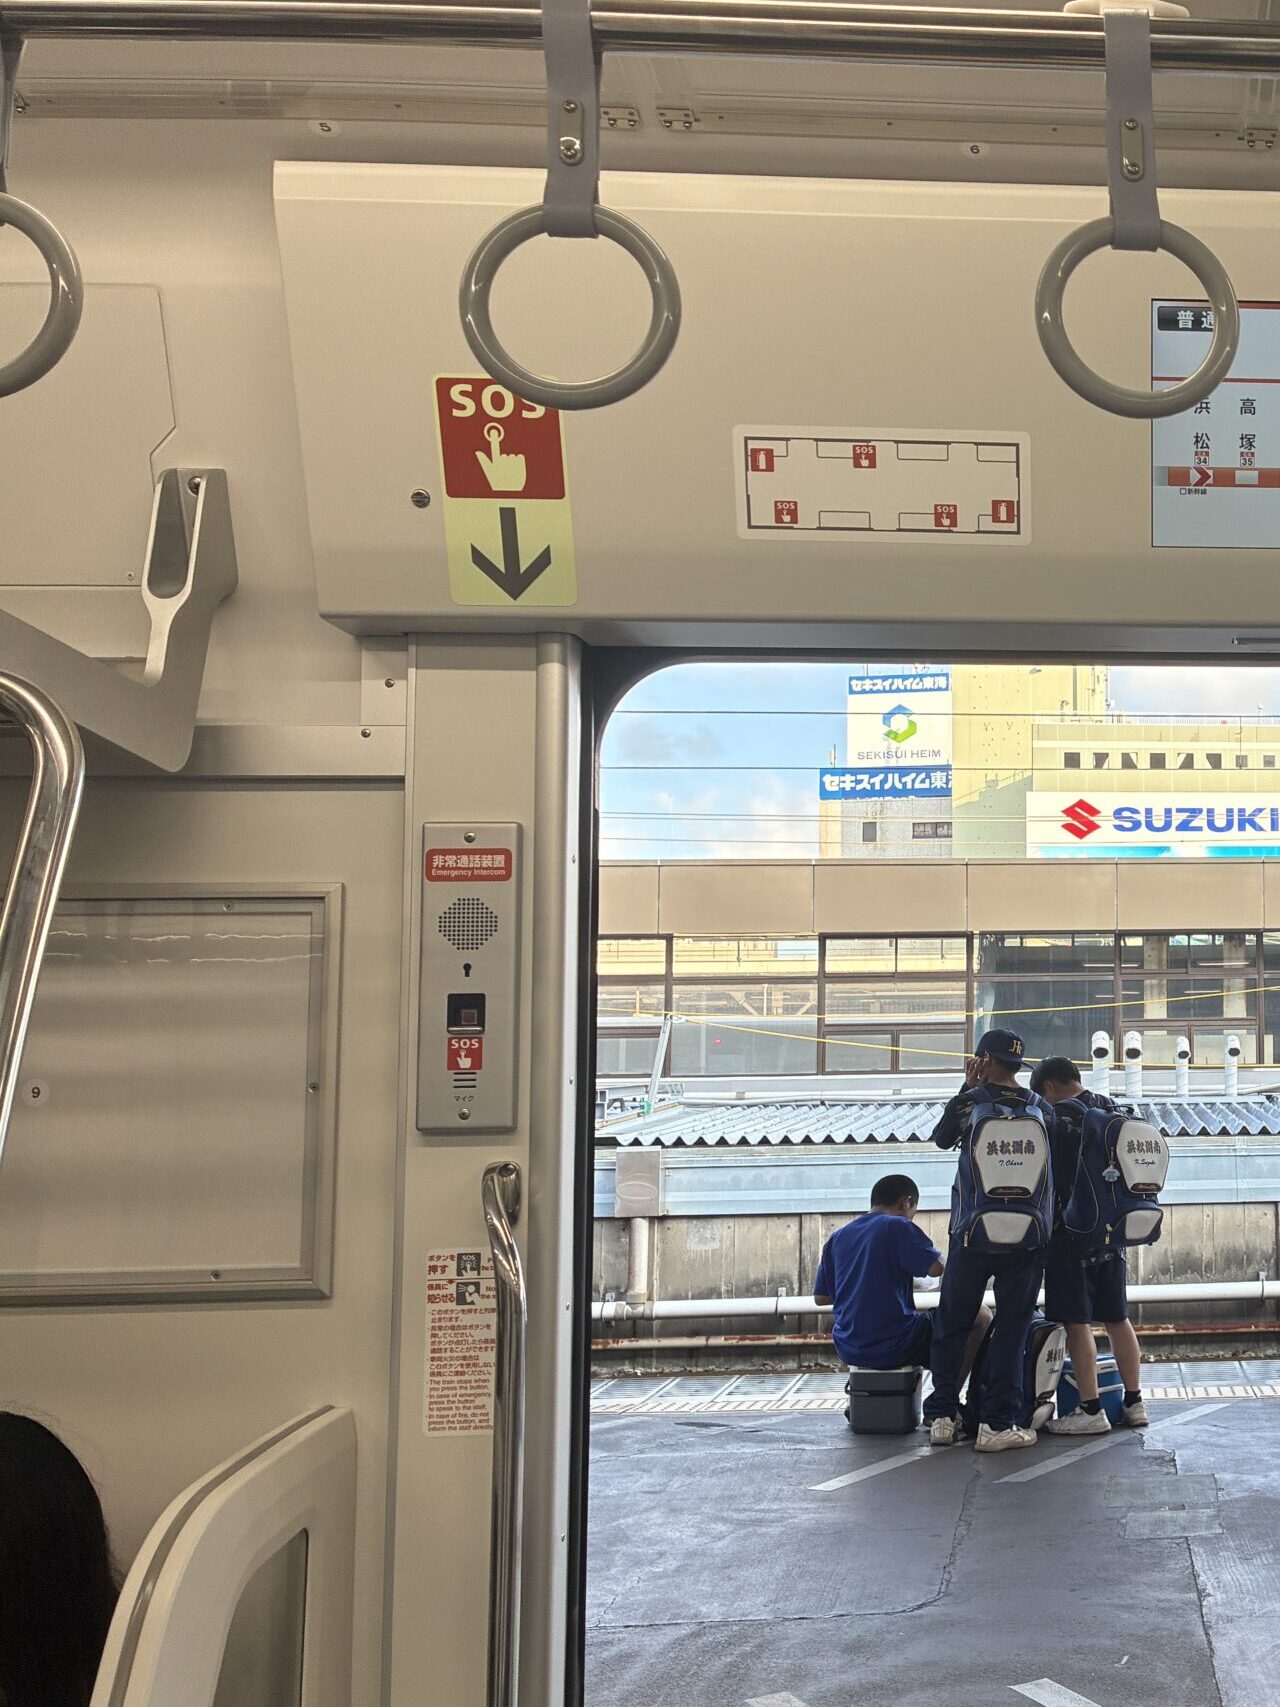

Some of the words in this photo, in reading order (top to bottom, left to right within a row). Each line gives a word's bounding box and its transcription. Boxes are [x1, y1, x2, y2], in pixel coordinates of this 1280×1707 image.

[319, 122, 331, 132] 5
[970, 144, 980, 154] 6
[1177, 310, 1216, 329] 普通
[1239, 397, 1256, 450] 高塚
[855, 445, 874, 454] SOS
[1196, 457, 1208, 465] 34
[1242, 458, 1253, 466] 35
[777, 501, 796, 510] SOS
[936, 505, 955, 514] SOS
[851, 676, 947, 692] セキスイハイム東海
[857, 750, 907, 761] SEKISUI
[910, 749, 941, 759] HEIM
[822, 772, 953, 791] セキスイハイム東
[1112, 806, 1280, 833] SUZUKI
[432, 854, 505, 868] 非常通話装置
[431, 868, 472, 877] Emergency
[473, 868, 506, 876] Intercom
[451, 1038, 479, 1049] SOS
[31, 1086, 41, 1099] 9
[454, 1095, 474, 1103] マイク
[428, 1254, 456, 1262] ボタンを
[428, 1264, 448, 1275] 押す
[427, 1293, 456, 1304] 知らせる
